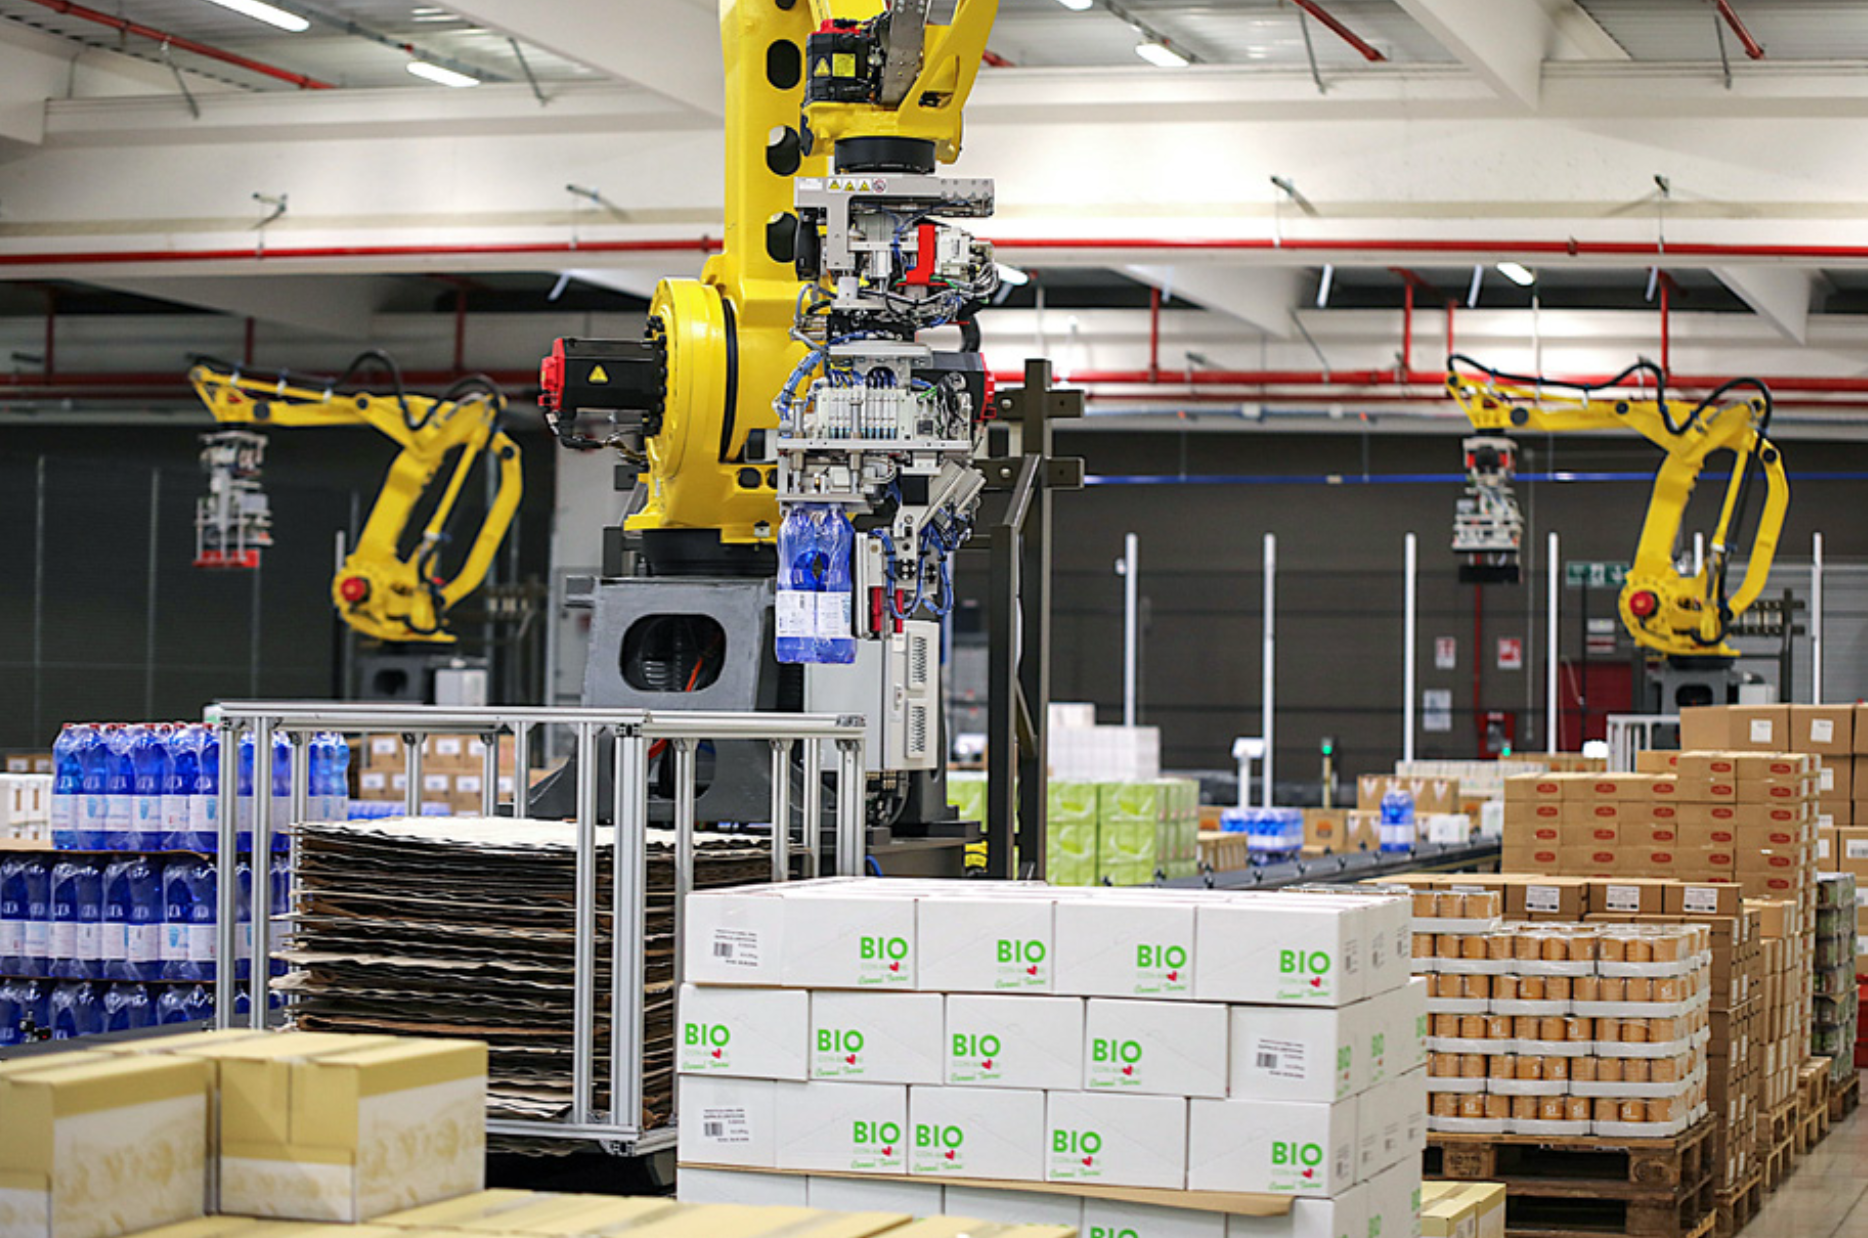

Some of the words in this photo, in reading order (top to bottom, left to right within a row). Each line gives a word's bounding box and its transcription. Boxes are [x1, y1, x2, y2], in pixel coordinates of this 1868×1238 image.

[860, 936, 909, 961] BIO
[997, 939, 1047, 964] BIO
[1136, 944, 1187, 970] BIO
[1279, 949, 1331, 976] BIO
[684, 1022, 731, 1048] BIO
[817, 1028, 864, 1053] BIO
[952, 1033, 1001, 1058] BIO
[1092, 1038, 1143, 1064] BIO
[853, 1120, 901, 1145] BIO
[915, 1124, 964, 1149] BIO
[1052, 1129, 1102, 1155] BIO
[1272, 1141, 1323, 1167] BIO
